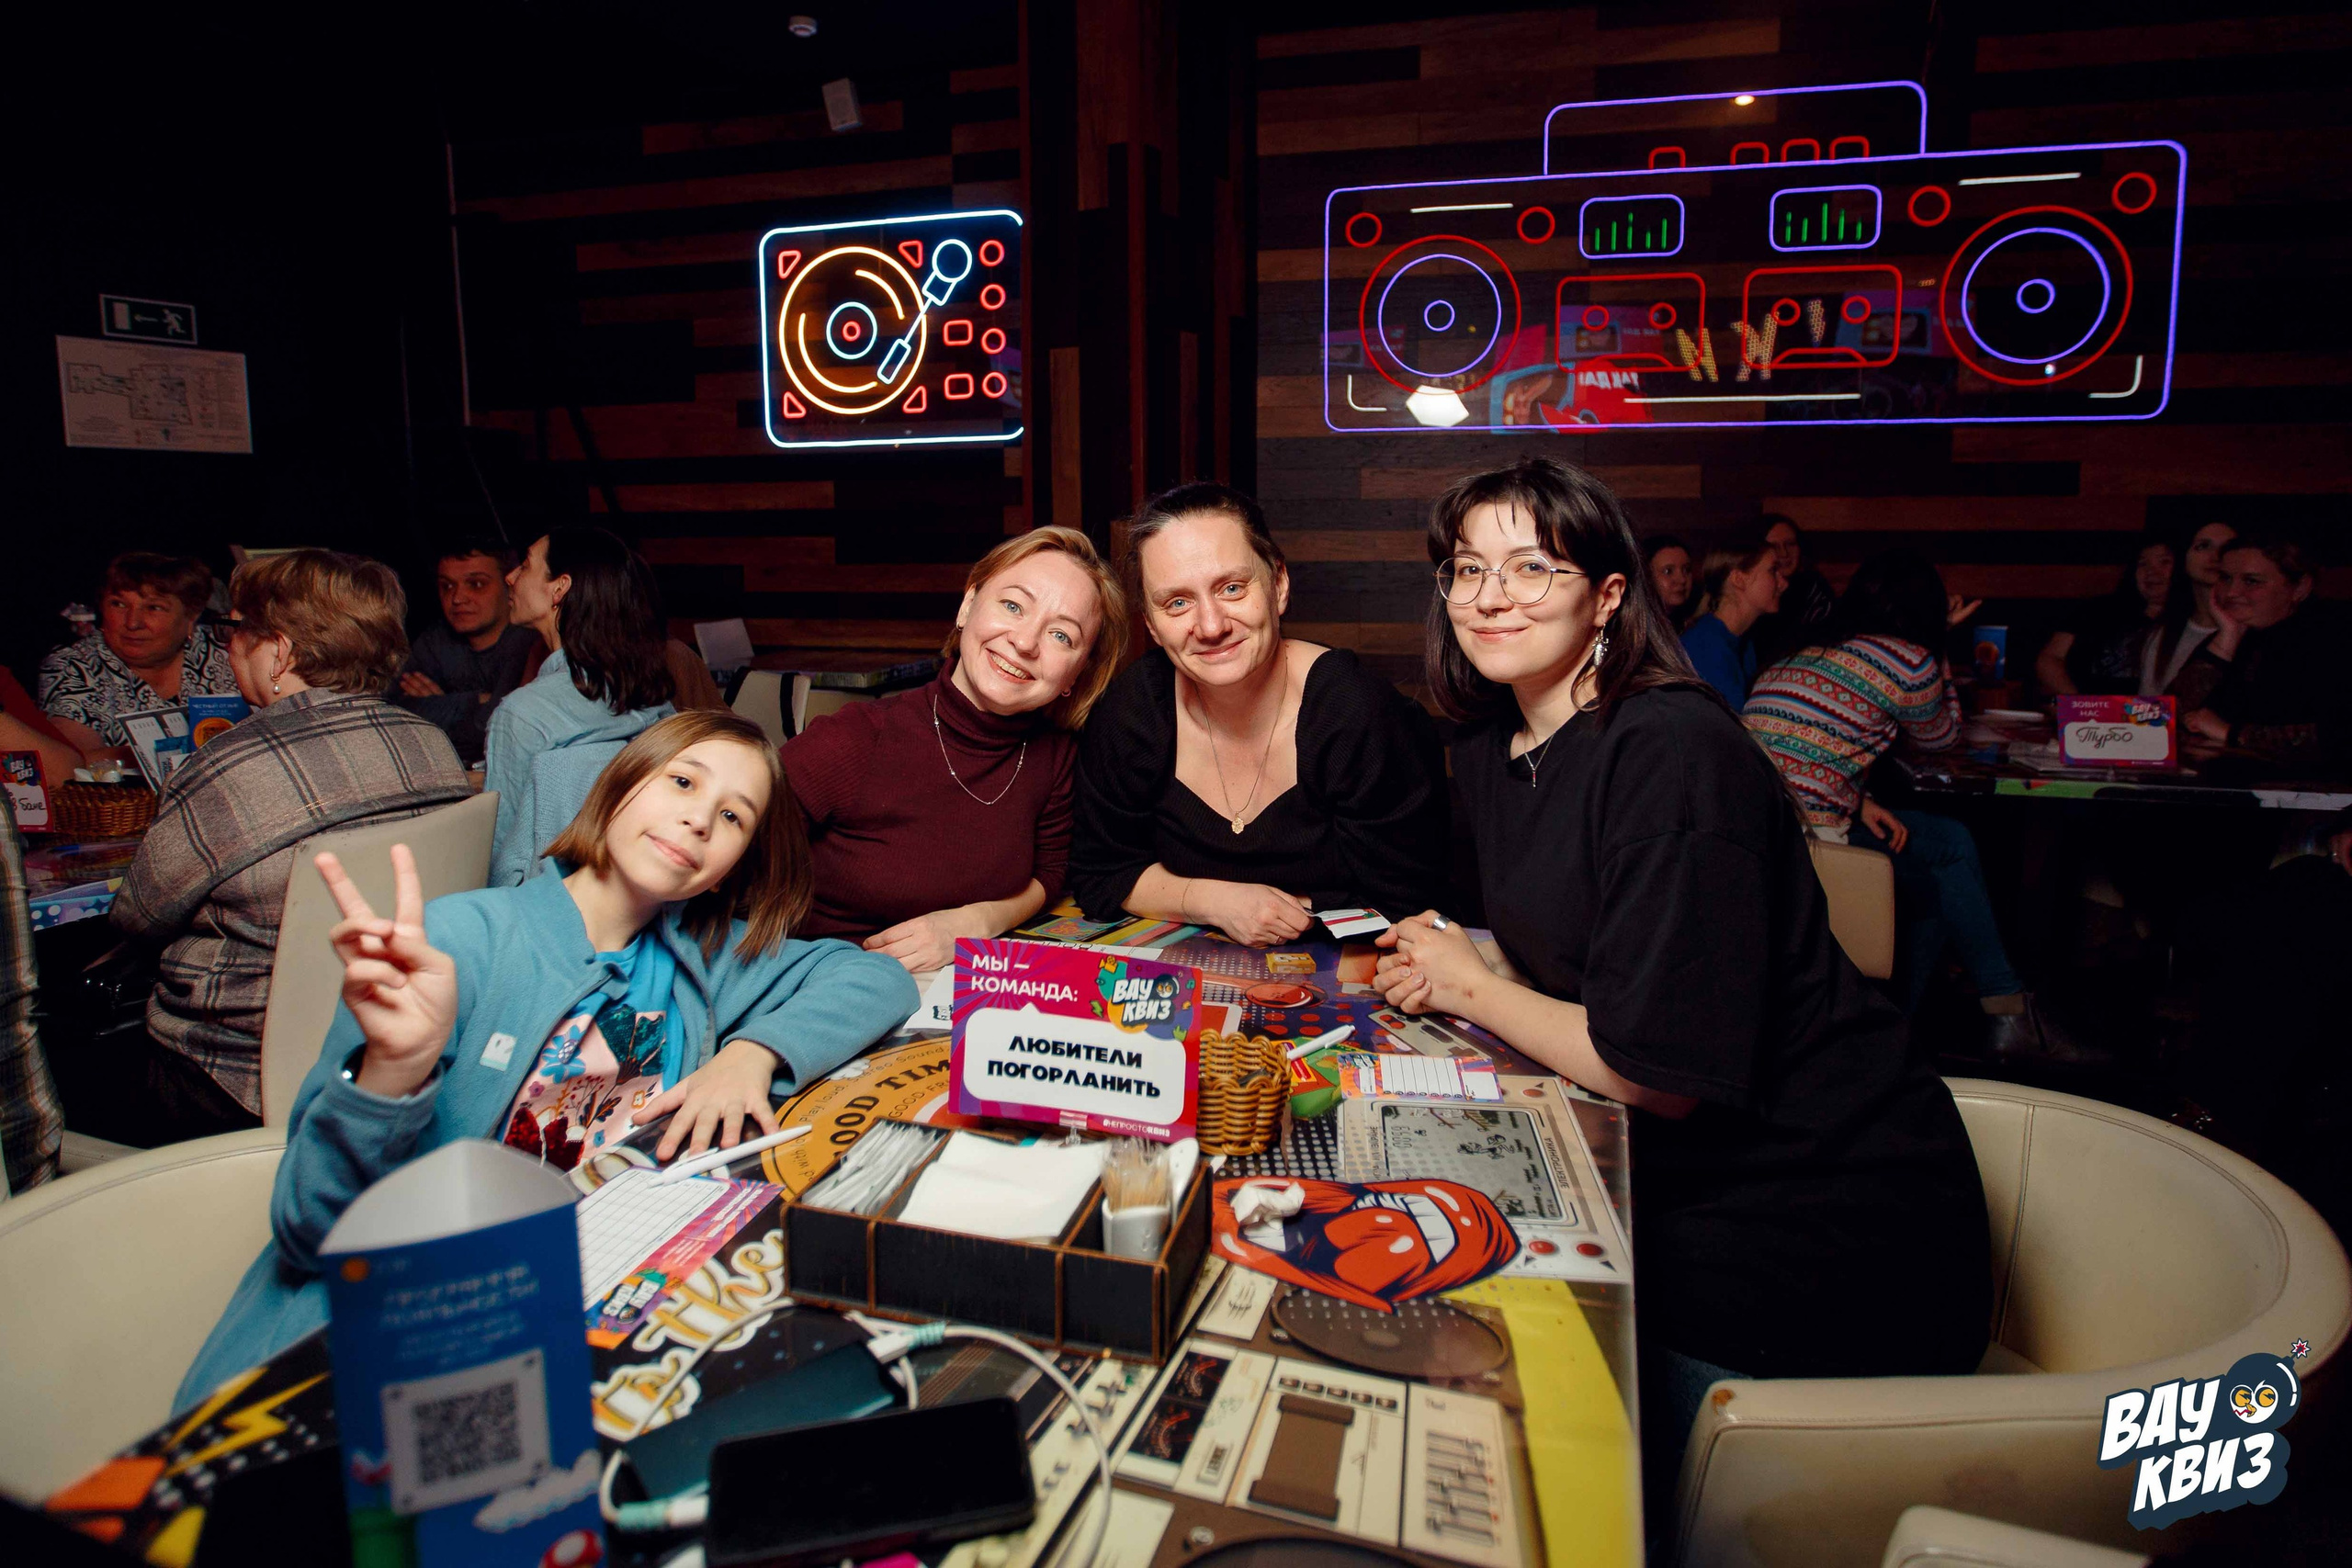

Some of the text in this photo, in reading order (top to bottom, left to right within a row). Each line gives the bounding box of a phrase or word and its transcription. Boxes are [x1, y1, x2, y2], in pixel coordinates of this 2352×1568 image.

[2076, 727, 2133, 749] Турбо
[971, 953, 1009, 972] МЫ
[970, 976, 1079, 1002] КОМАНДА:
[1113, 977, 1154, 1002] ВАУ
[1121, 998, 1171, 1023] КВИЗ
[1009, 1035, 1143, 1069] ЛЮБИТЕЛИ
[987, 1060, 1161, 1099] ПОГОРЛАНИТЬ
[888, 1091, 925, 1119] GOOD
[830, 1095, 880, 1159] OOD
[1544, 1136, 1569, 1189] ЭЛЕКТРОНИКА
